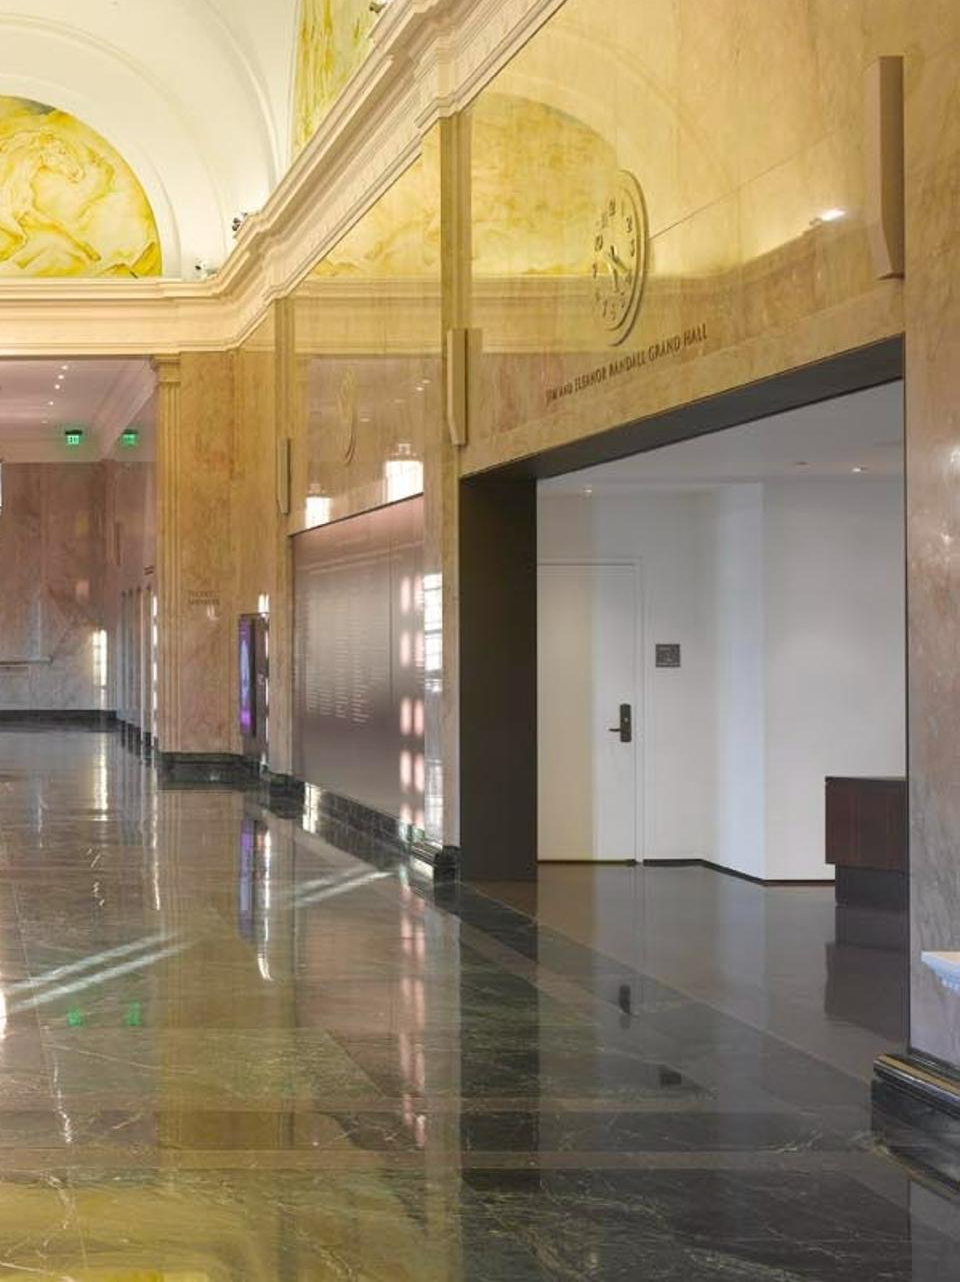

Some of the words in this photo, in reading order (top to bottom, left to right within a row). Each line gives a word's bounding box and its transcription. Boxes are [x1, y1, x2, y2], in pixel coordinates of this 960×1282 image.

[574, 366, 606, 393] ELEANOR
[609, 349, 646, 377] RANDALL
[648, 335, 681, 361] GRAND
[683, 322, 707, 347] HALL
